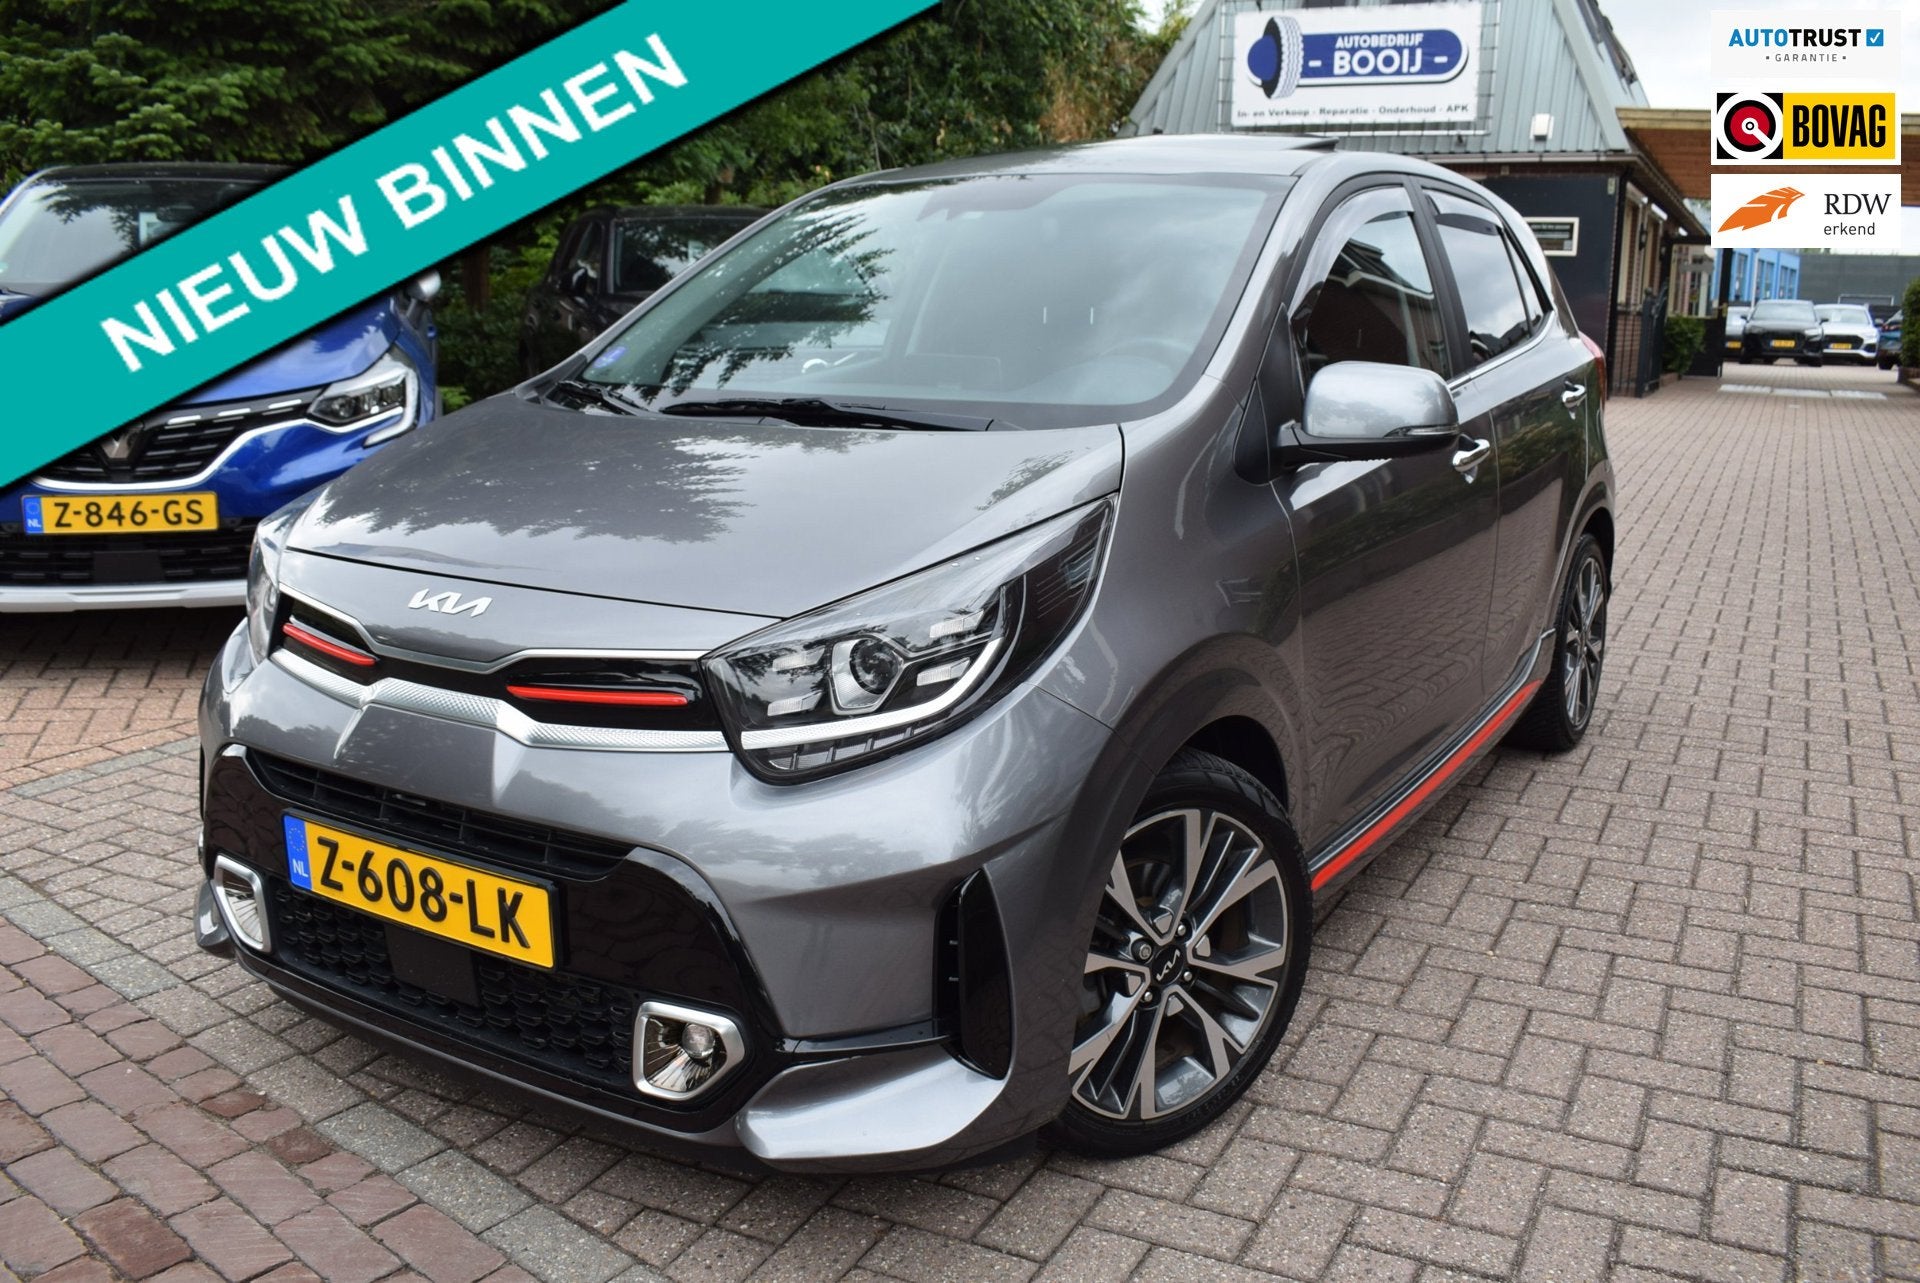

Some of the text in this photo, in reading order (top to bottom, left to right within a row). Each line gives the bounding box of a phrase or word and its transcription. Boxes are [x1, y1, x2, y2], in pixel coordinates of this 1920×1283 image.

[1335, 33, 1424, 49] AUTOBEDRIJF
[1333, 48, 1422, 76] BOOIJ
[1268, 108, 1309, 117] Verkoop
[1319, 106, 1369, 116] Reparatie
[1378, 105, 1436, 115] Onderhoud
[1446, 104, 1469, 113] APK
[27, 518, 41, 528] NL
[54, 499, 204, 528] Z-846-GS
[292, 858, 309, 878] NL
[317, 836, 531, 949] Z-608-LK
